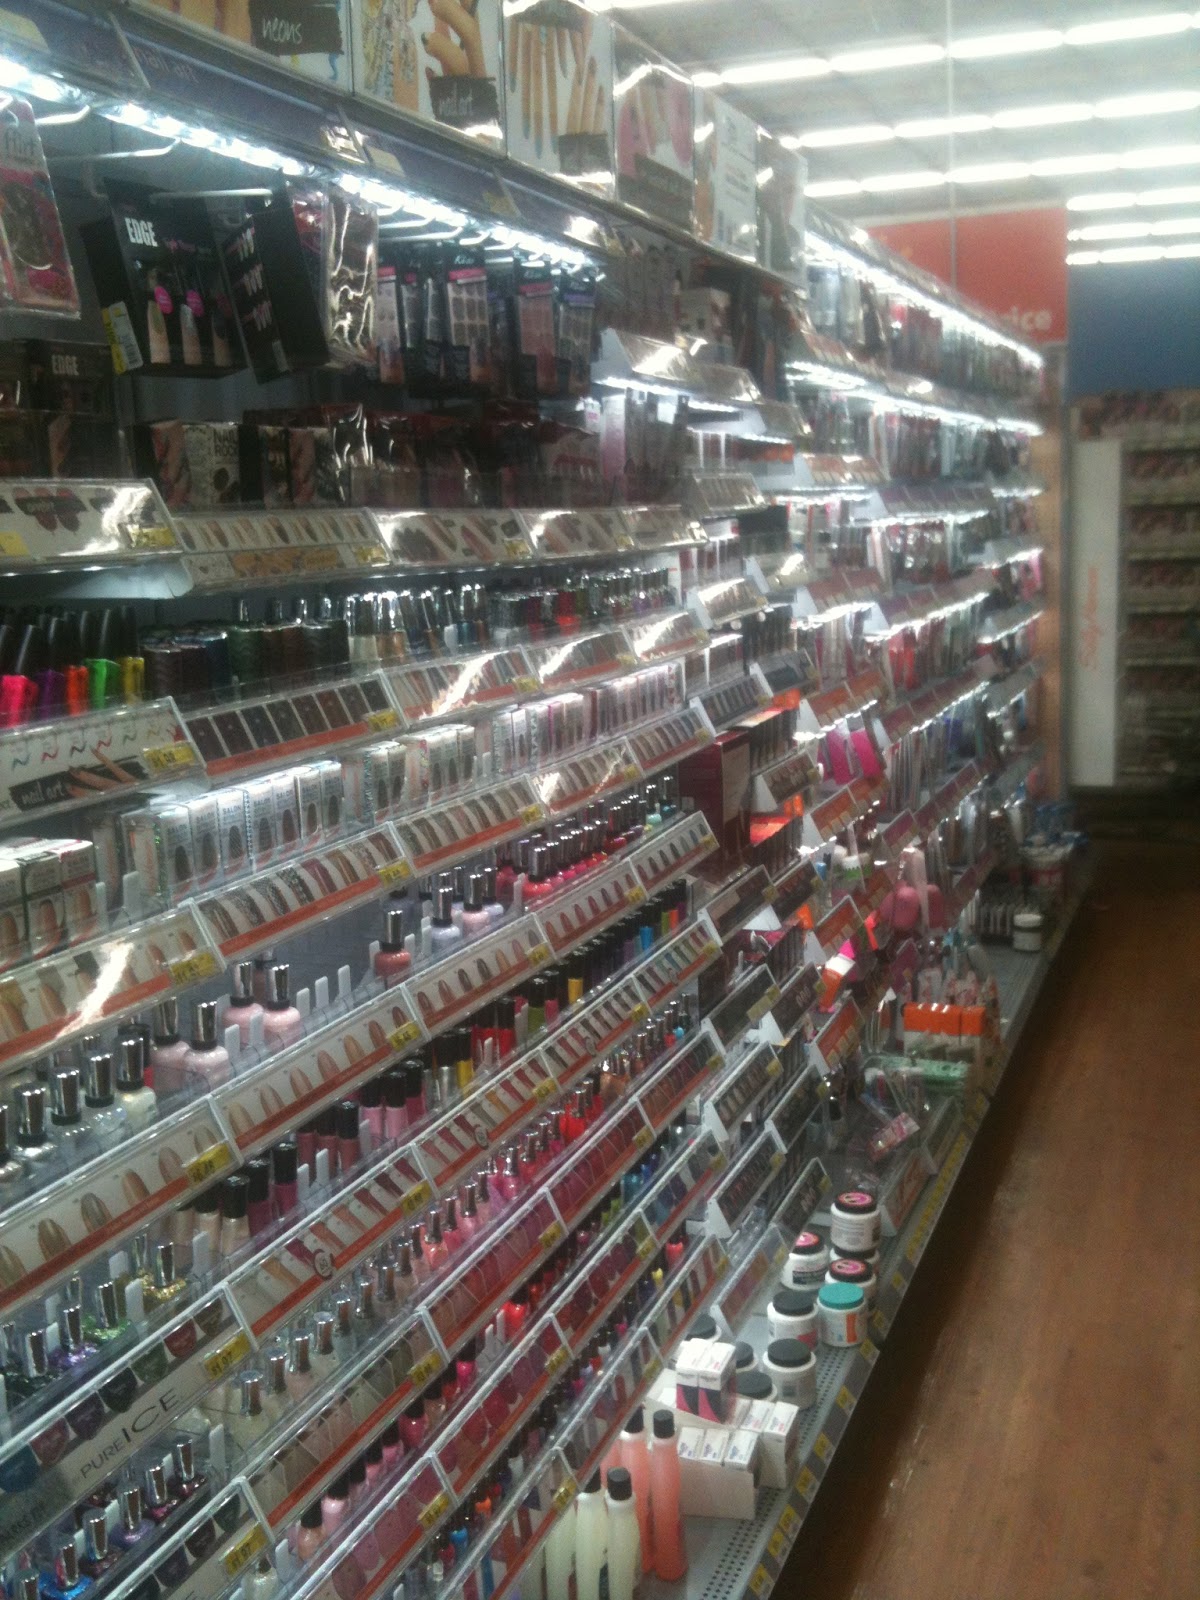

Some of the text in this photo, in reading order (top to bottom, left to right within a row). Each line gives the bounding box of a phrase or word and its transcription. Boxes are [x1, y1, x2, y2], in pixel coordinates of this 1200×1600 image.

[262, 17, 303, 44] neons
[124, 216, 159, 248] EDGE
[51, 354, 79, 376] EDGE
[21, 780, 66, 805] nail art
[80, 1387, 180, 1479] PURE ICE
